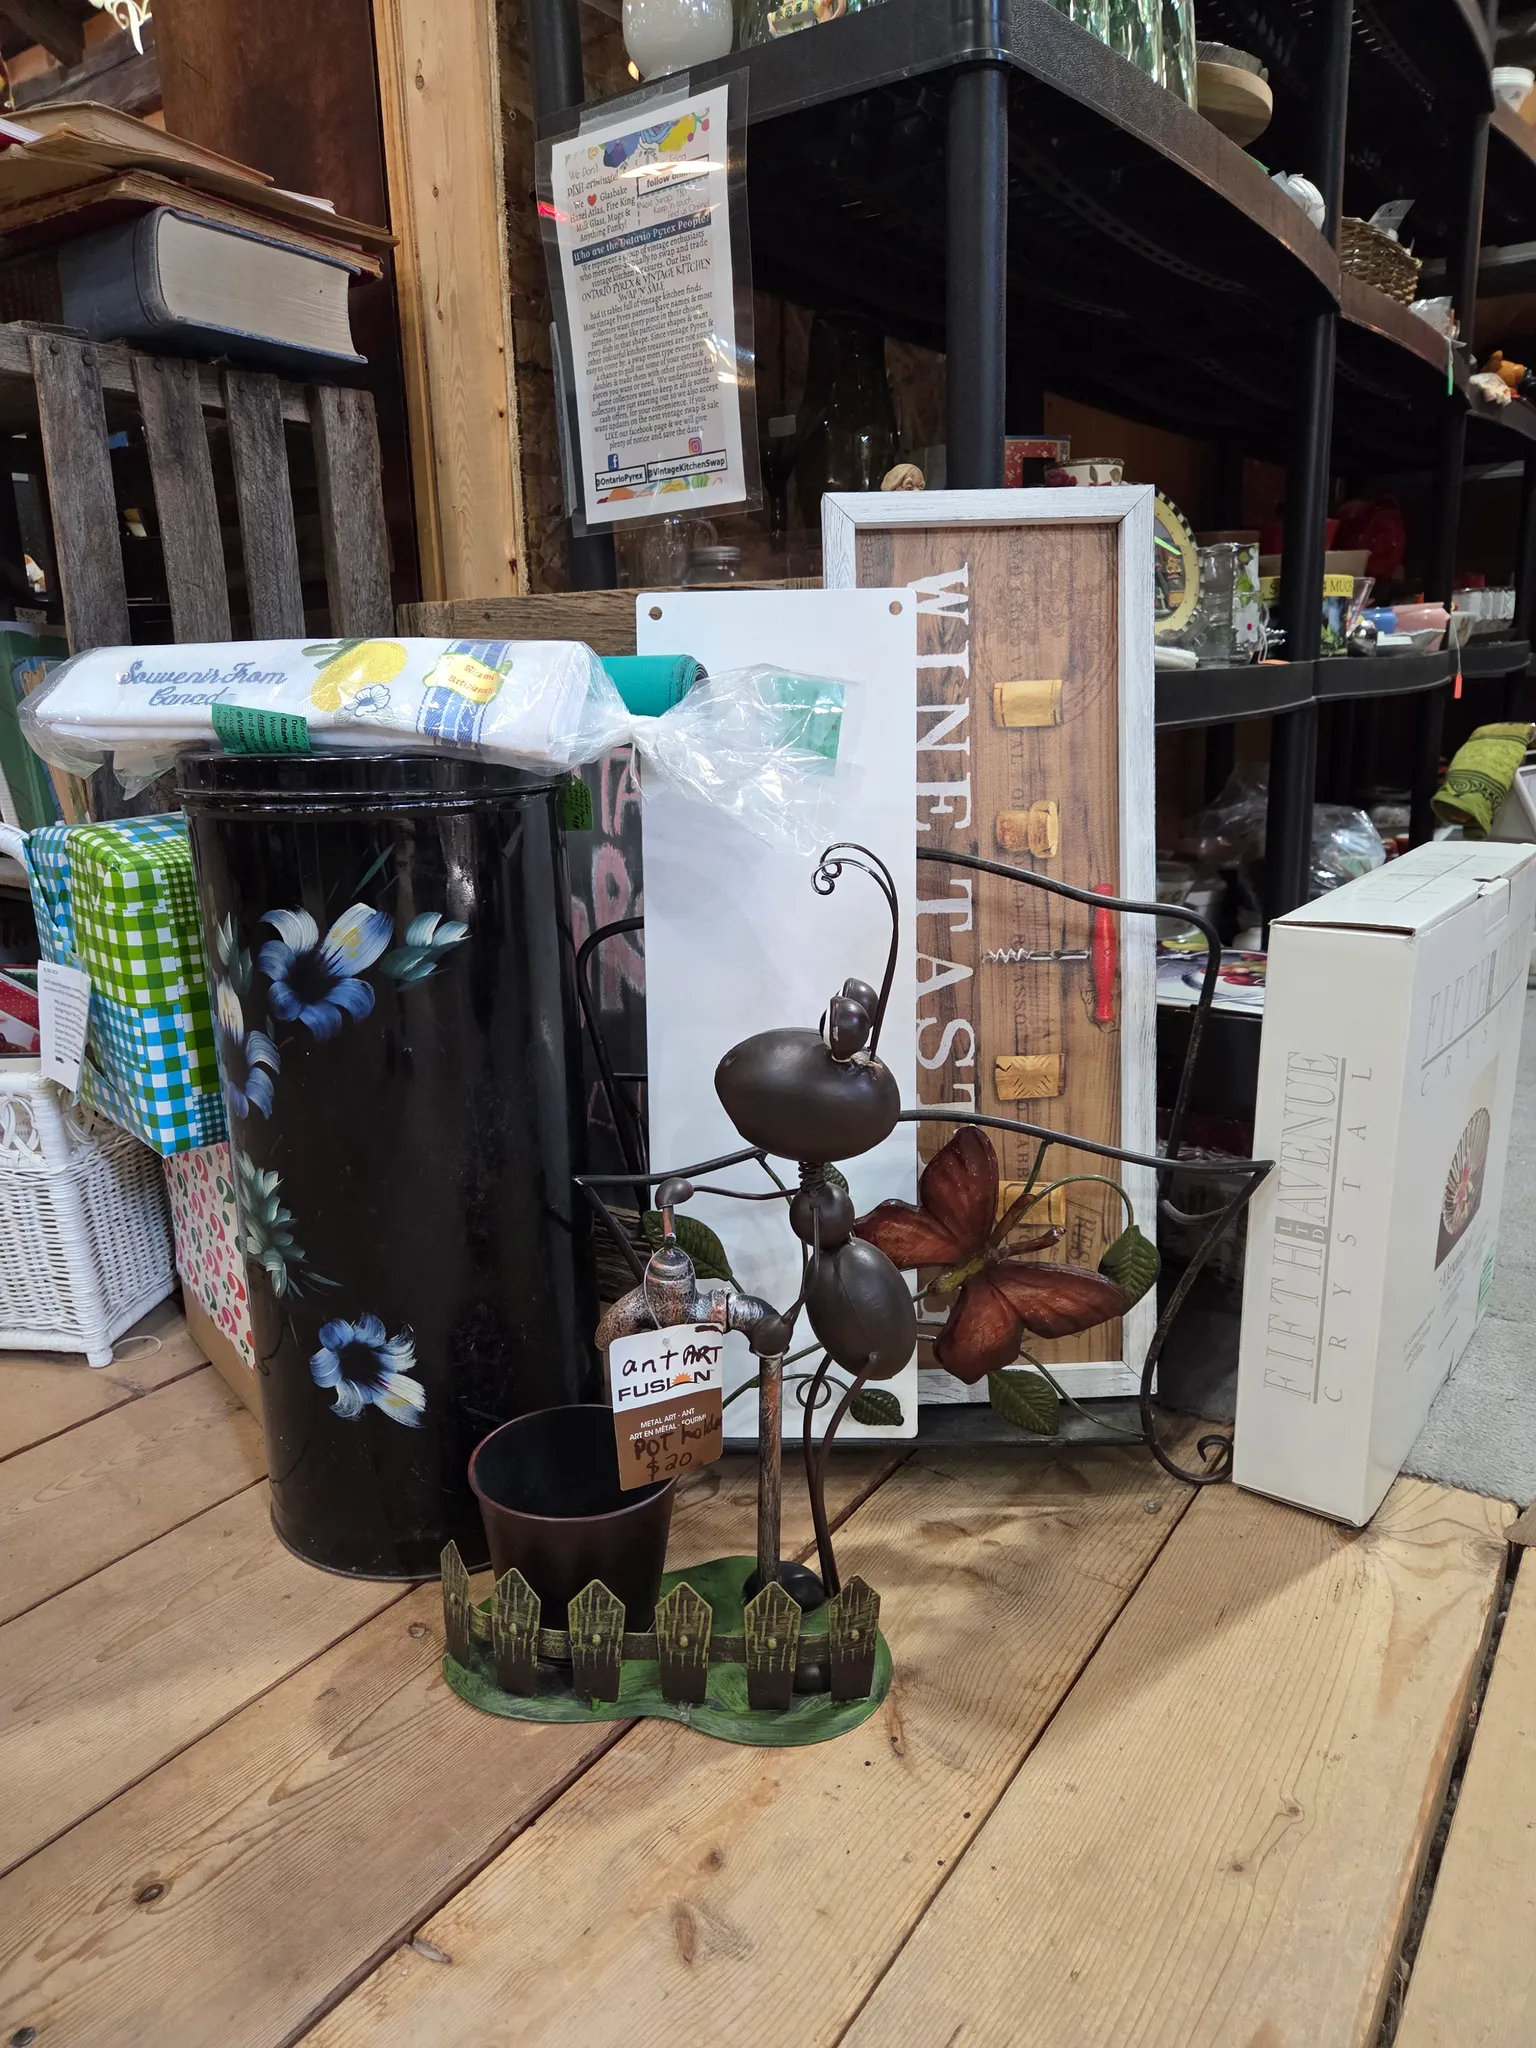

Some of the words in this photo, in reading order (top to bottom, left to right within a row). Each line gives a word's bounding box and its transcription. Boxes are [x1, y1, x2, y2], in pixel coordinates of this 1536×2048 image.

[599, 184, 627, 201] Glasbake
[646, 173, 669, 188] follow
[588, 203, 605, 218] Atlas,
[606, 199, 619, 211] Fire
[620, 194, 635, 209] King
[589, 214, 606, 228] Glass,
[607, 209, 624, 224] Mugs
[667, 207, 679, 219] Find
[573, 248, 590, 261] Who
[591, 246, 604, 256] are
[605, 239, 618, 251] the
[620, 230, 650, 247] Ontario
[653, 222, 675, 240] Pyrex
[677, 211, 709, 232] People?
[579, 225, 605, 244] Anything
[606, 218, 627, 235] Funky!
[119, 658, 221, 685] Souvenir
[221, 661, 288, 685] From
[149, 686, 231, 707] Canad
[906, 562, 971, 831] WINE
[248, 712, 256, 728] and
[280, 717, 289, 744] Ontario
[291, 719, 299, 744] Dealer
[1276, 1051, 1340, 1226] AVENUE
[1323, 1066, 1373, 1403] CRYSTAL
[1263, 1238, 1323, 1402] FIFTH
[622, 1349, 679, 1376] ant
[683, 1344, 723, 1366] ART
[640, 1418, 663, 1429] METAL
[663, 1413, 677, 1423] ART
[681, 1407, 695, 1418] ANT
[629, 1431, 643, 1441] ART
[644, 1429, 654, 1438] EN
[655, 1424, 677, 1436] MÉTAL
[646, 1452, 692, 1481] $20
